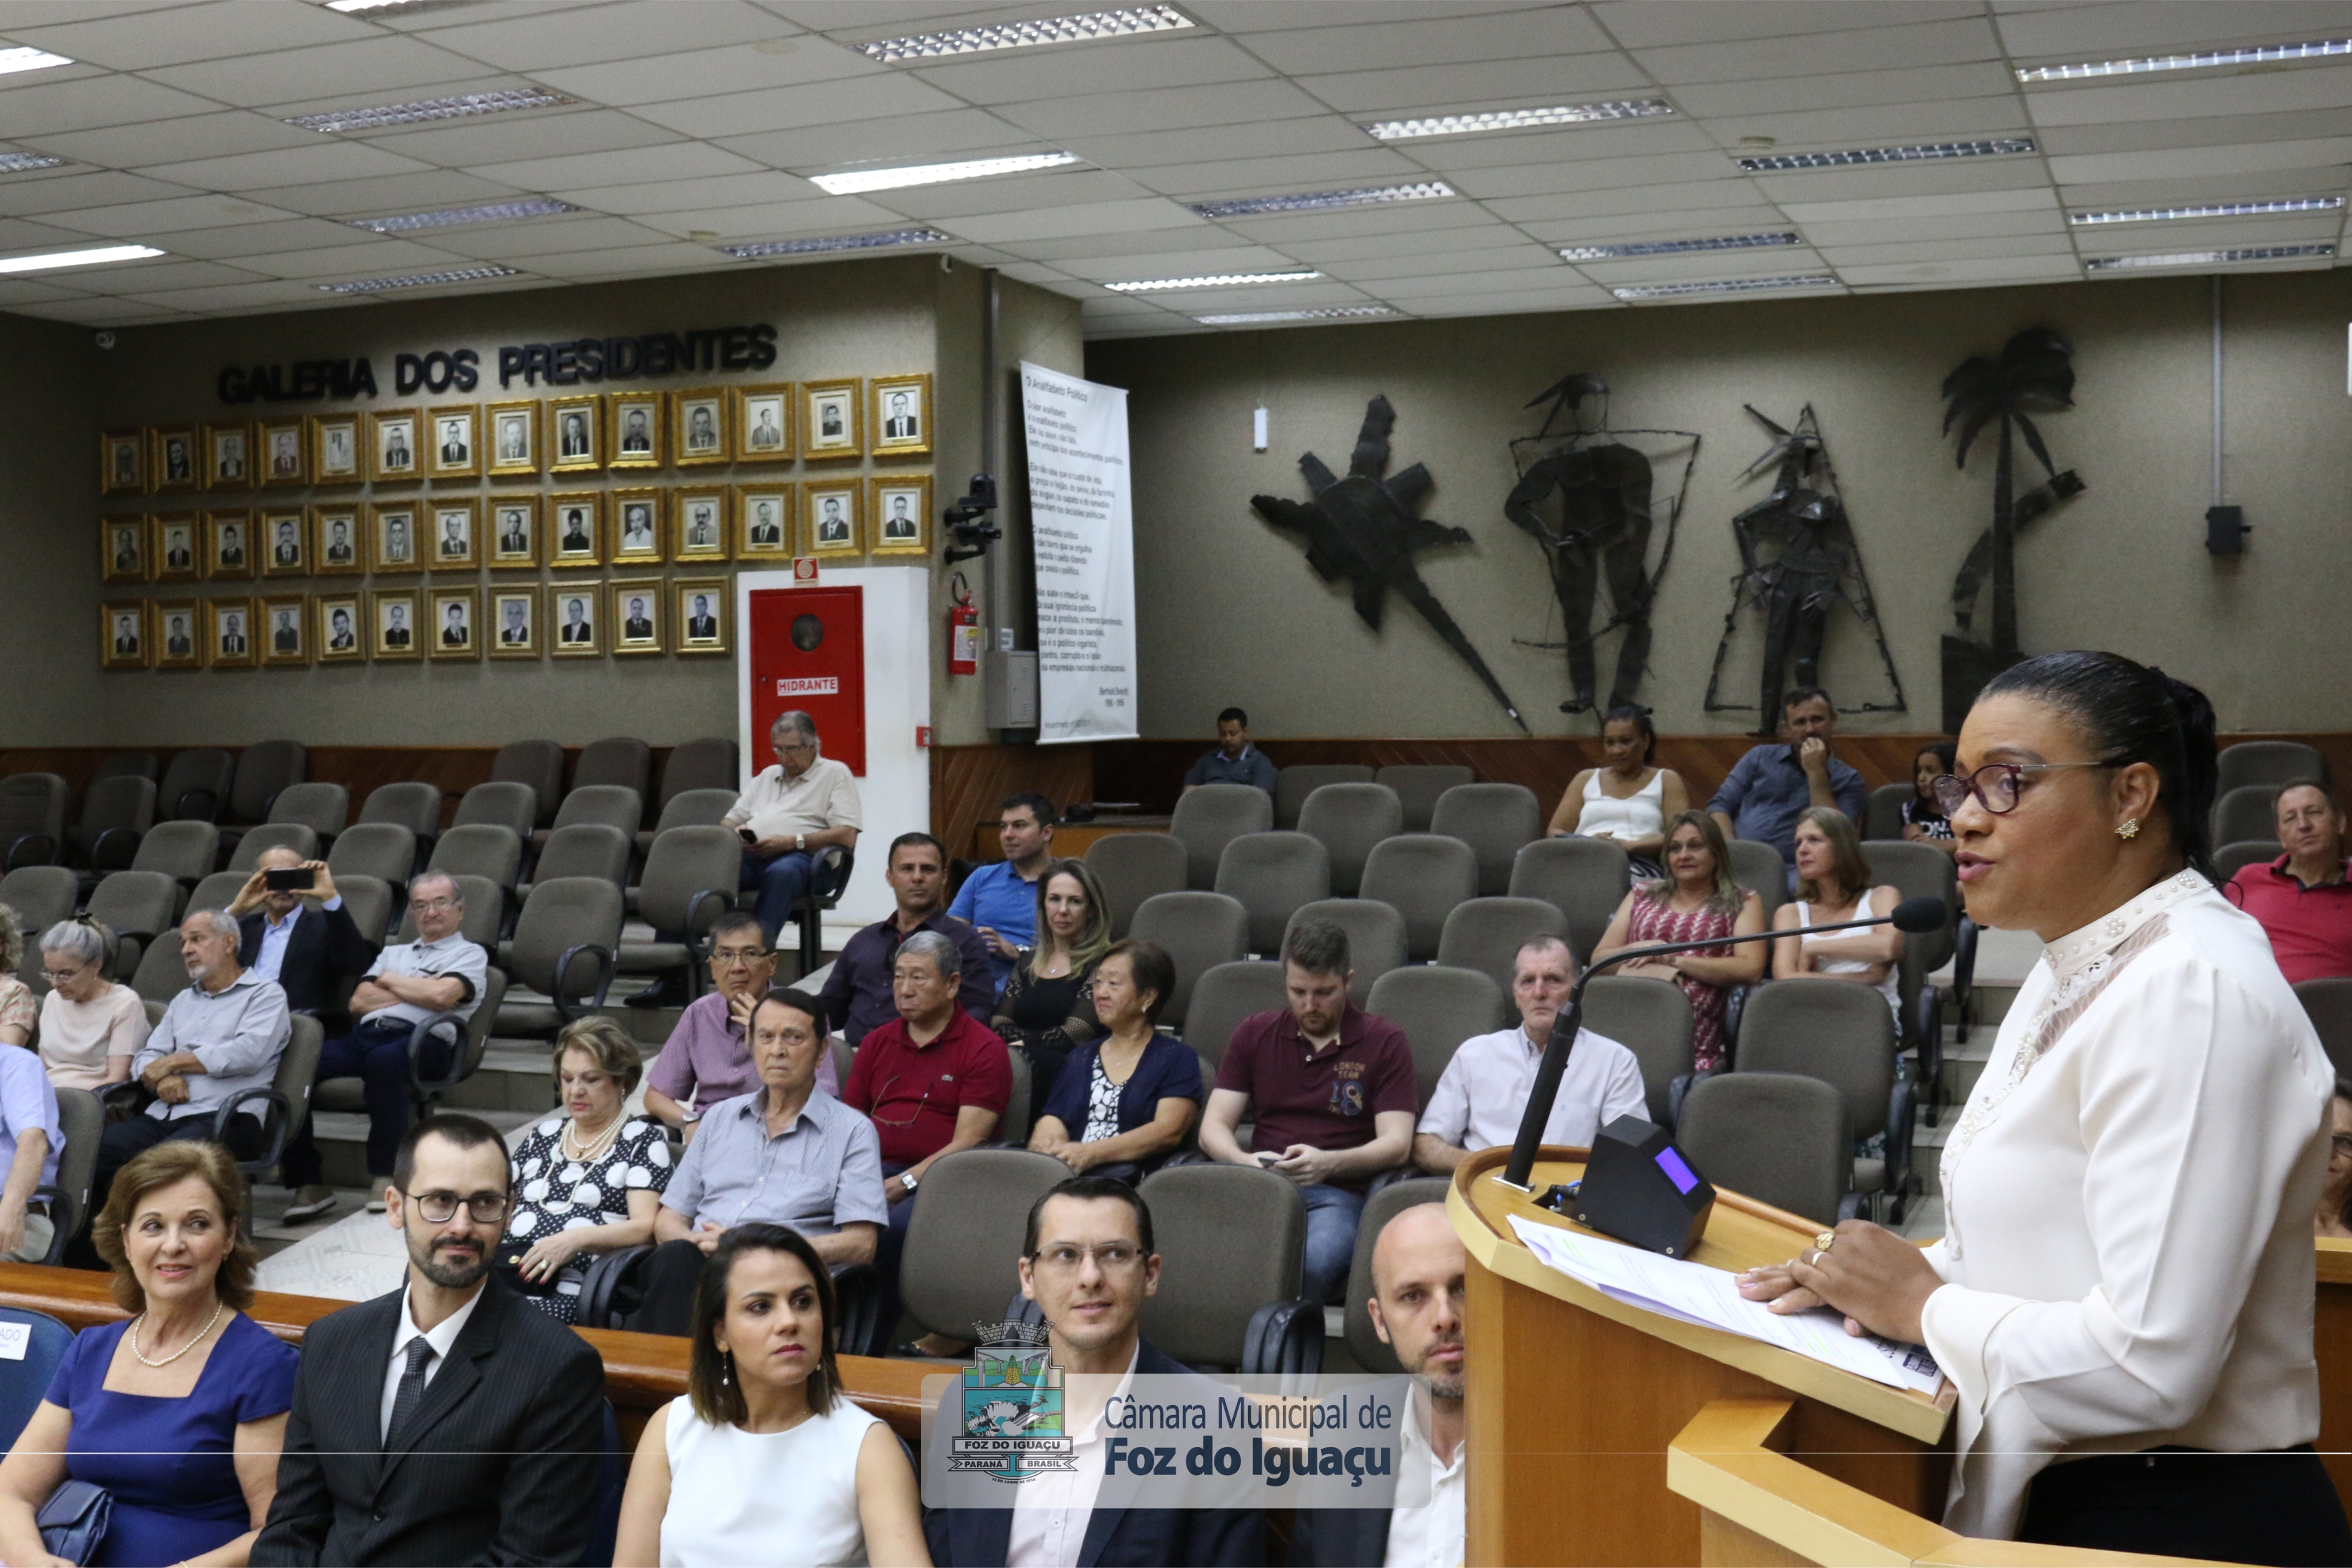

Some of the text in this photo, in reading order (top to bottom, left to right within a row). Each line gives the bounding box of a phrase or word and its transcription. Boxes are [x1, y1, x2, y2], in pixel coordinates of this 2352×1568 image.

[218, 323, 778, 405] GALERIA DOS PRESIDENTES
[1033, 379, 1065, 396] Analfabeto
[779, 678, 836, 692] HIDRANTE
[1334, 1062, 1365, 1072] LONDON
[1338, 1071, 1360, 1079] TEAM
[1329, 1081, 1364, 1116] 18
